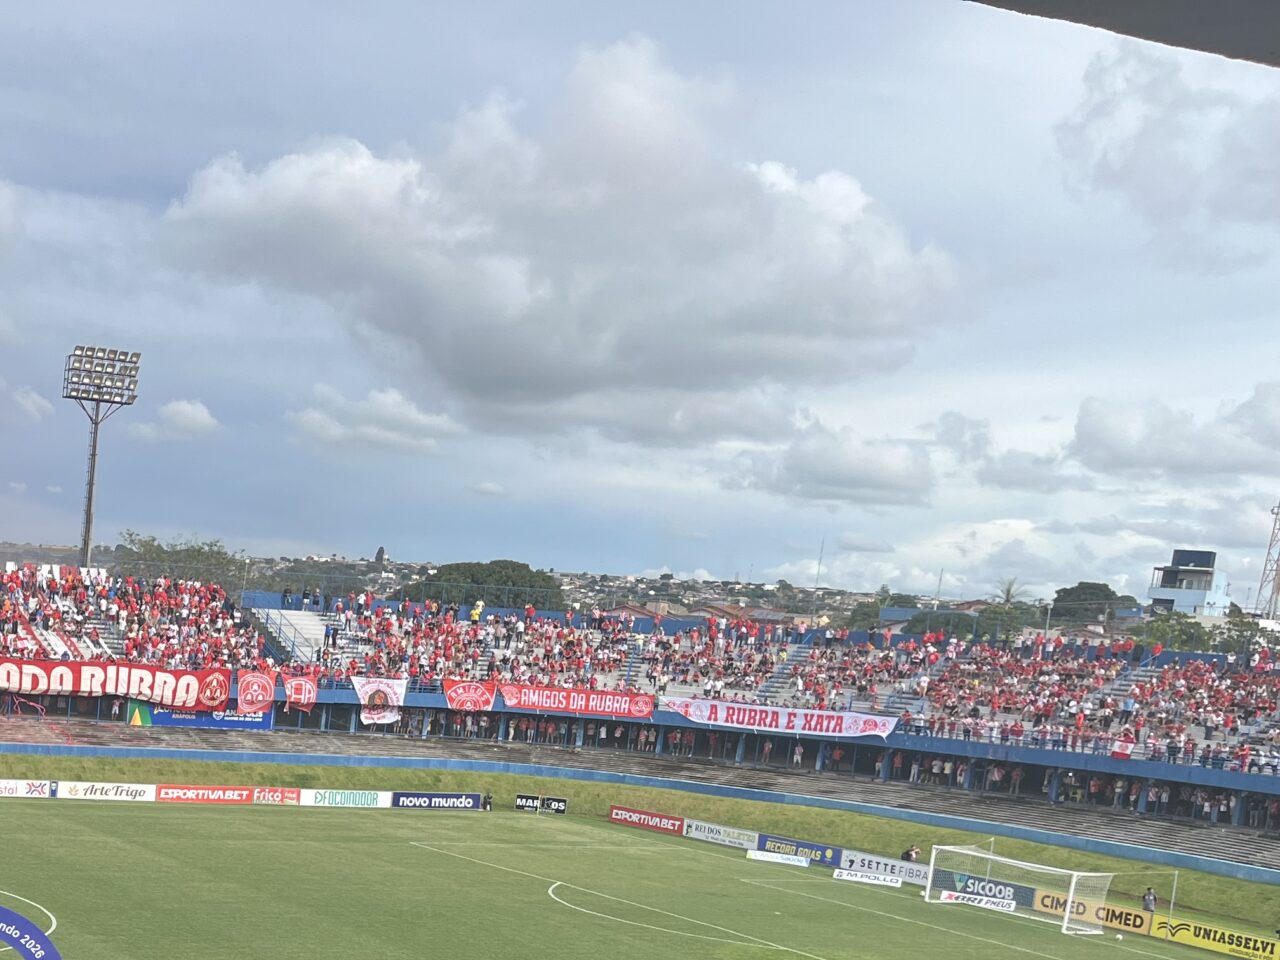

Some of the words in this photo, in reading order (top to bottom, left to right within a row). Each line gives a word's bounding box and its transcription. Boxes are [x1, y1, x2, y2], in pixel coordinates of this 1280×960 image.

[450, 685, 488, 702] AMIGOS
[521, 689, 567, 708] AMIGOS
[570, 692, 585, 709] DA
[589, 694, 630, 714] RUBRA
[707, 704, 718, 721] A
[724, 707, 780, 729] RUBRA
[802, 714, 844, 733] XATA
[160, 790, 249, 800] ESPORTIVABET
[254, 789, 281, 801] Fricó
[400, 797, 430, 807] novo
[431, 796, 473, 808] mundo
[612, 809, 681, 831] ESPORTIVABET
[707, 825, 722, 836] DOS
[765, 840, 796, 855] RECORD
[797, 847, 822, 861] GOIÁS
[846, 872, 899, 884] M.POLLO
[860, 858, 896, 874] SETTE
[898, 864, 929, 880] FIBRA
[966, 878, 1015, 900] SICOOB
[983, 898, 1013, 909] PNEUS
[1040, 895, 1087, 915] CIMED
[1095, 906, 1144, 928] CIMED
[19, 933, 46, 959] 2026
[1193, 925, 1276, 955] UNIASSELVI
